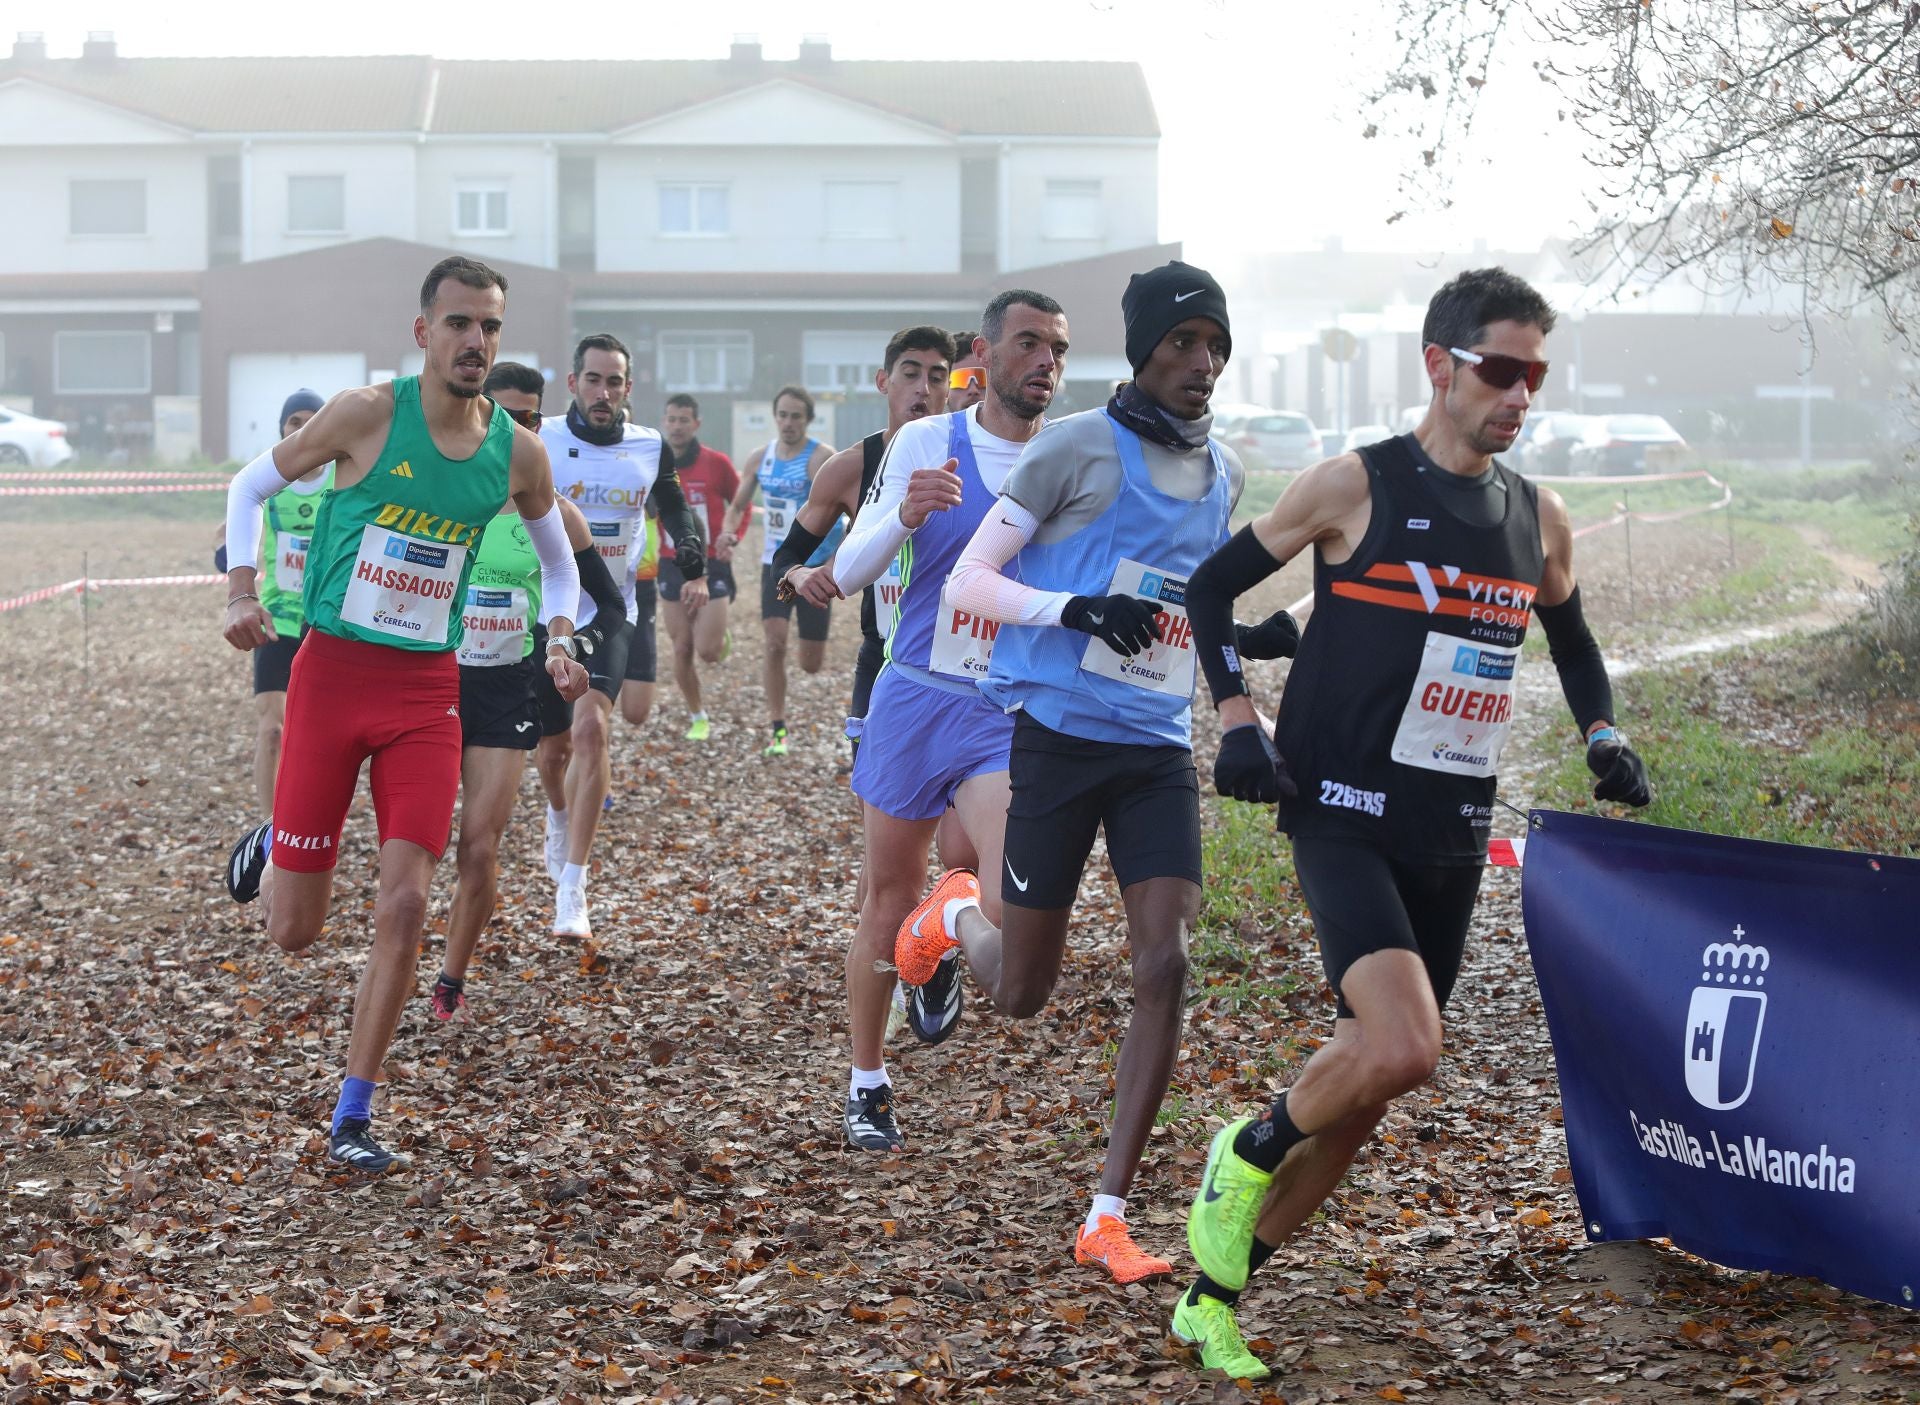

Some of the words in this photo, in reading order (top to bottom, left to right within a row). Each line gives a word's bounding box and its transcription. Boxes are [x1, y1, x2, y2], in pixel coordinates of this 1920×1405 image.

[357, 560, 454, 600] HASSAOUS
[1467, 581, 1535, 610] VICKY
[397, 603, 404, 613] 2
[383, 616, 421, 631] CEREALTO
[1470, 607, 1525, 629] FOODS
[469, 652, 501, 660] CEREALTO
[1148, 652, 1153, 662] 1
[1130, 665, 1166, 682] CEREALTO
[1464, 735, 1473, 746] 7
[1445, 751, 1488, 766] CEREALTO
[1319, 780, 1386, 817] 226ERS
[277, 830, 331, 849] BIKILA
[1744, 1135, 1856, 1193] Mancha
